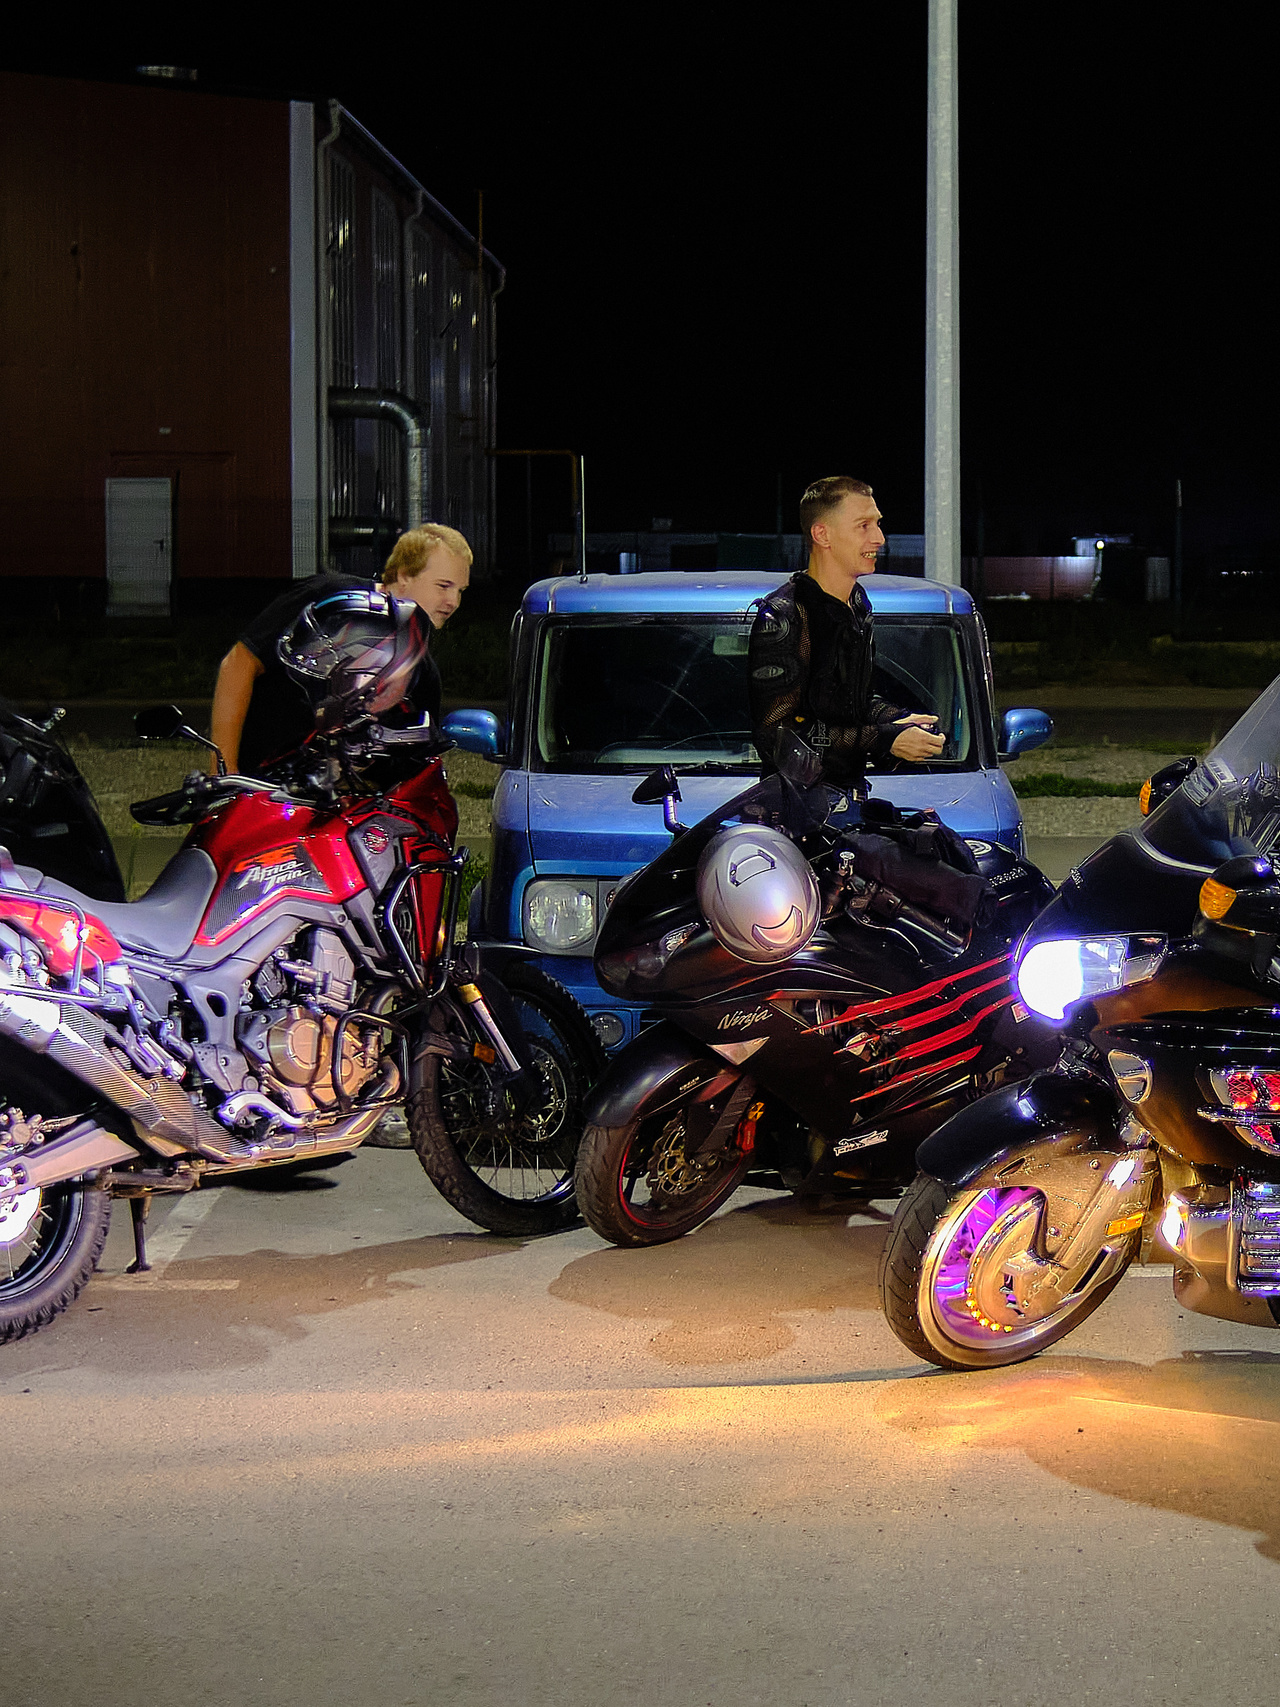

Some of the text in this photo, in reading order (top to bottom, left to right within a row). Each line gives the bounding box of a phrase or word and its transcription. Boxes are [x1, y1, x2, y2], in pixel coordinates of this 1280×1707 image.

[238, 860, 304, 889] Africa
[264, 870, 311, 894] Twin
[717, 1006, 773, 1031] Ninja
